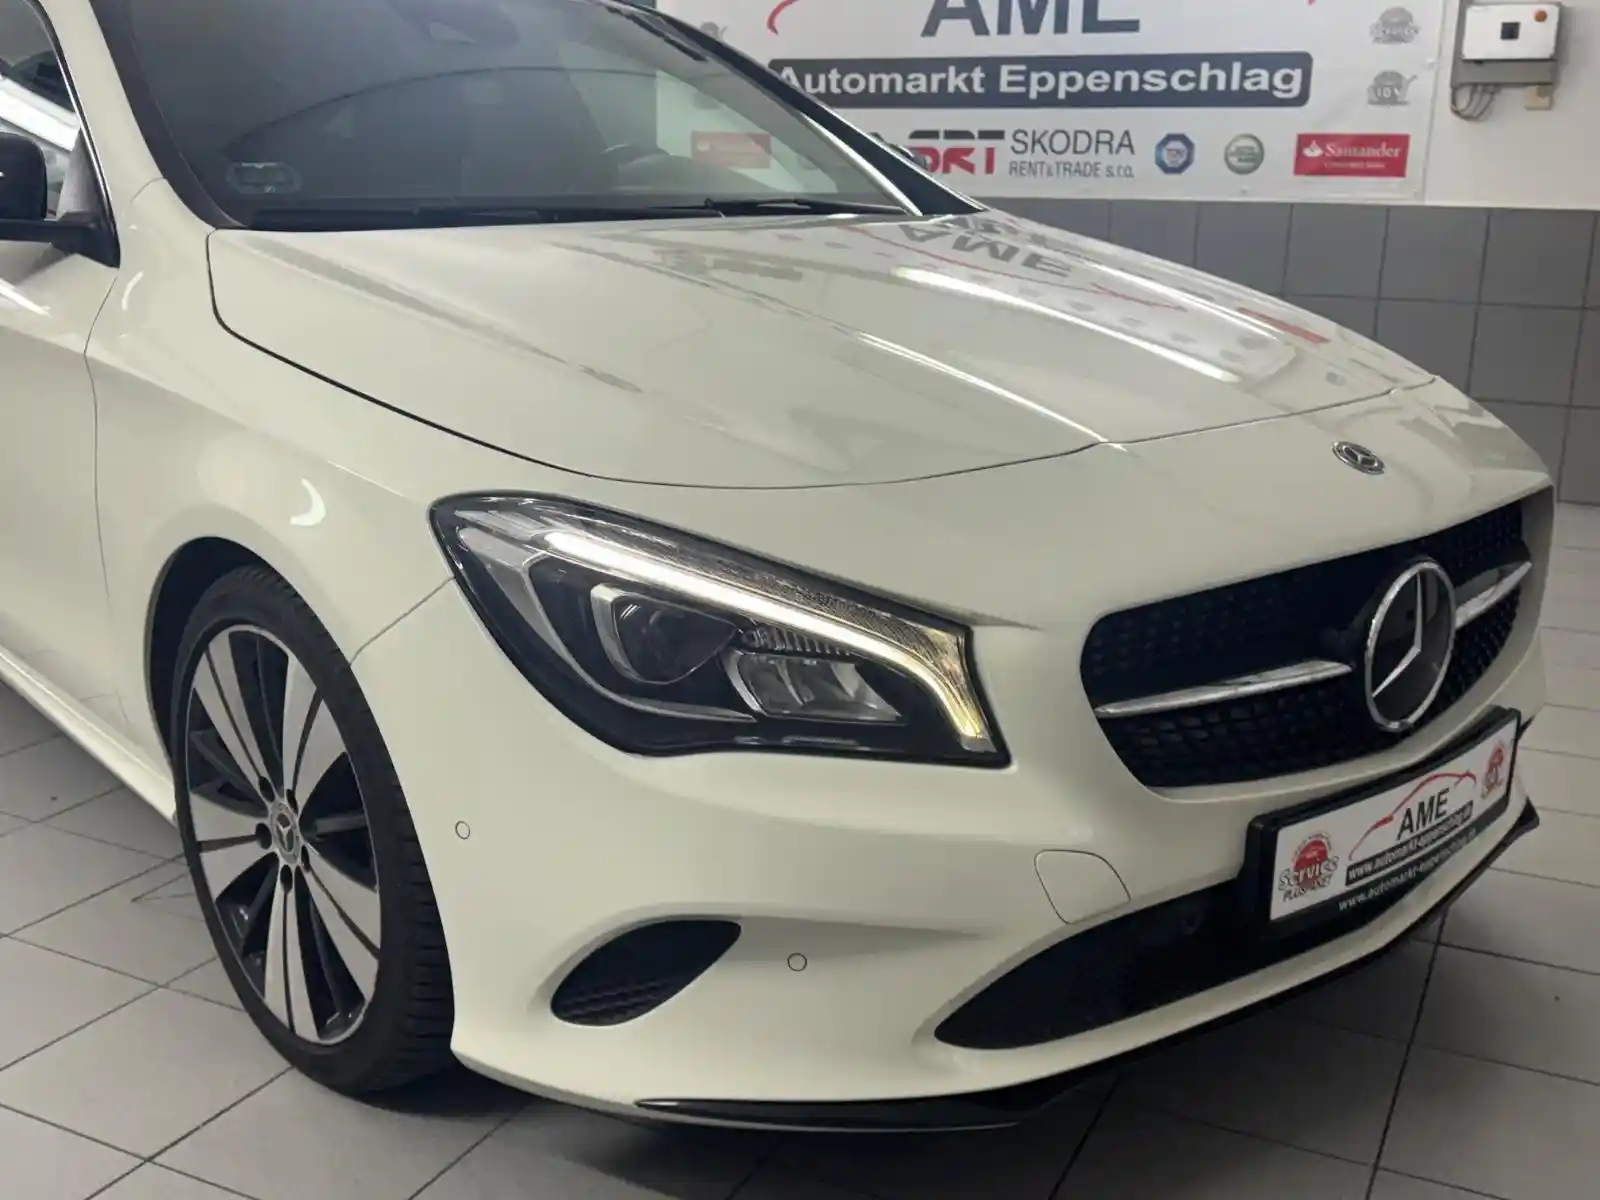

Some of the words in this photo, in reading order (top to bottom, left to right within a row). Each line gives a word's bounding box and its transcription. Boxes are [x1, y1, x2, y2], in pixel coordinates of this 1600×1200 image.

[779, 65, 985, 95] Automarkt
[1000, 61, 1304, 98] Eppenschlag
[1010, 129, 1136, 155] SKODRA
[1325, 141, 1401, 158] Santander
[1397, 787, 1450, 841] AME
